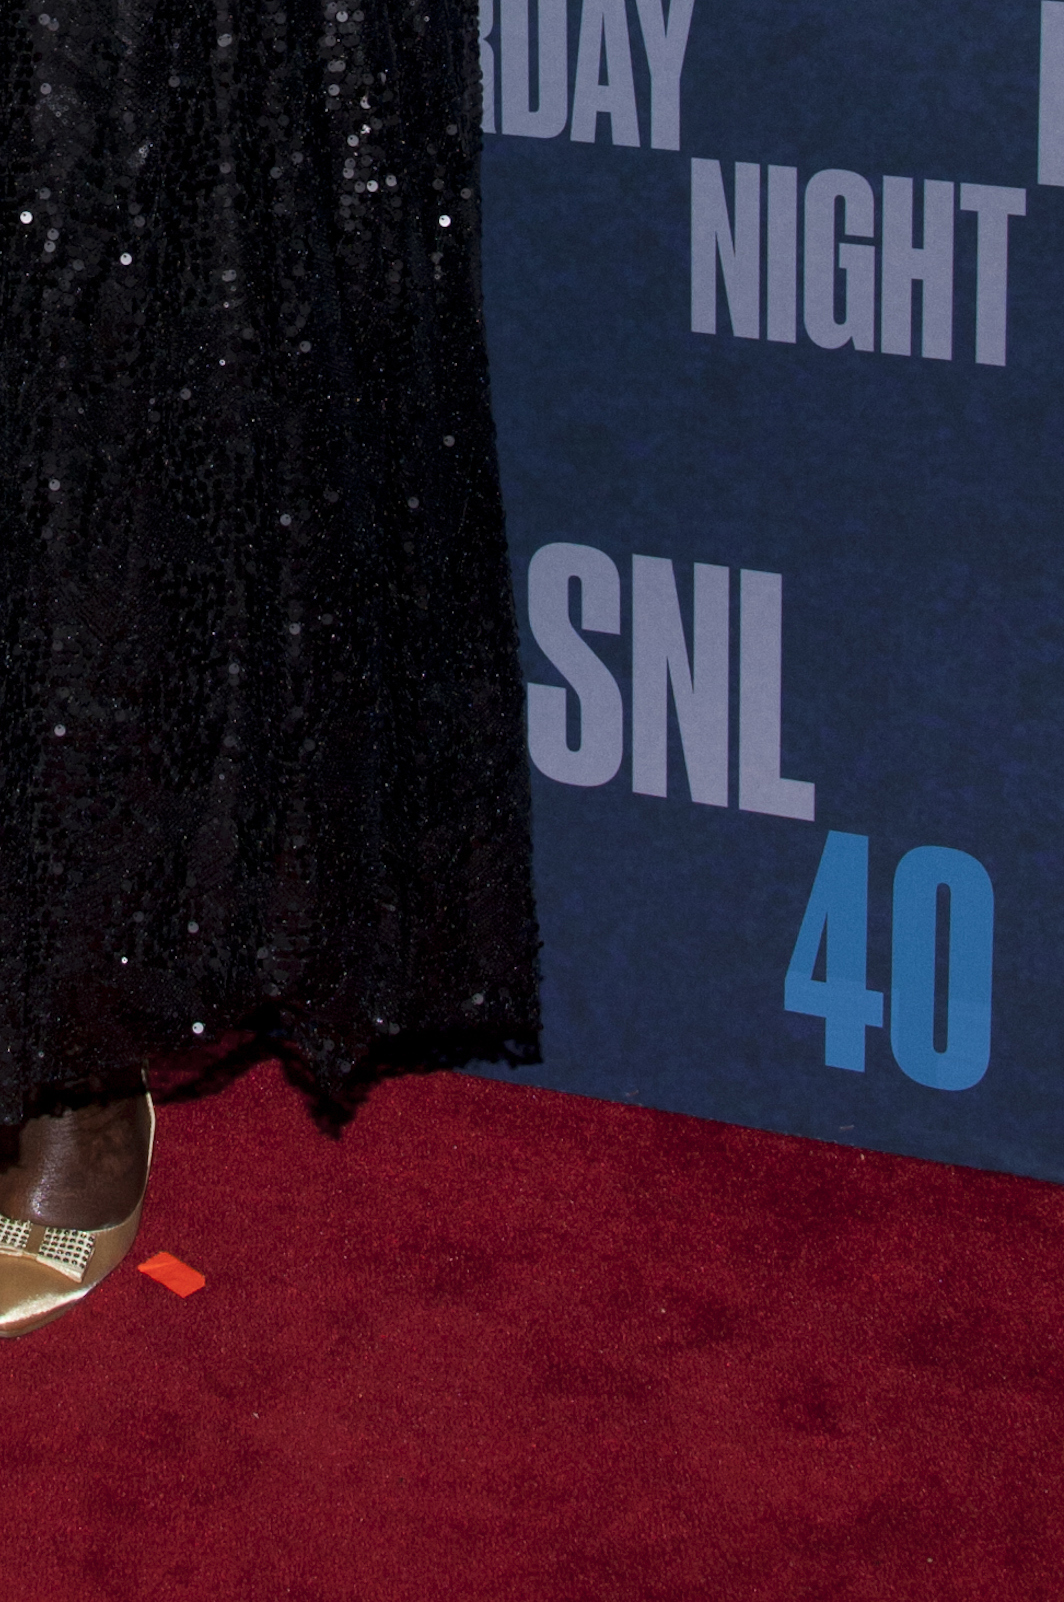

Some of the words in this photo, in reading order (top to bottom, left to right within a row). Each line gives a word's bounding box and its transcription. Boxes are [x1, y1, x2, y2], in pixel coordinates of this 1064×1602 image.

[690, 156, 1026, 367] NIGHT
[526, 541, 815, 822] SNL
[784, 829, 994, 1091] 40
